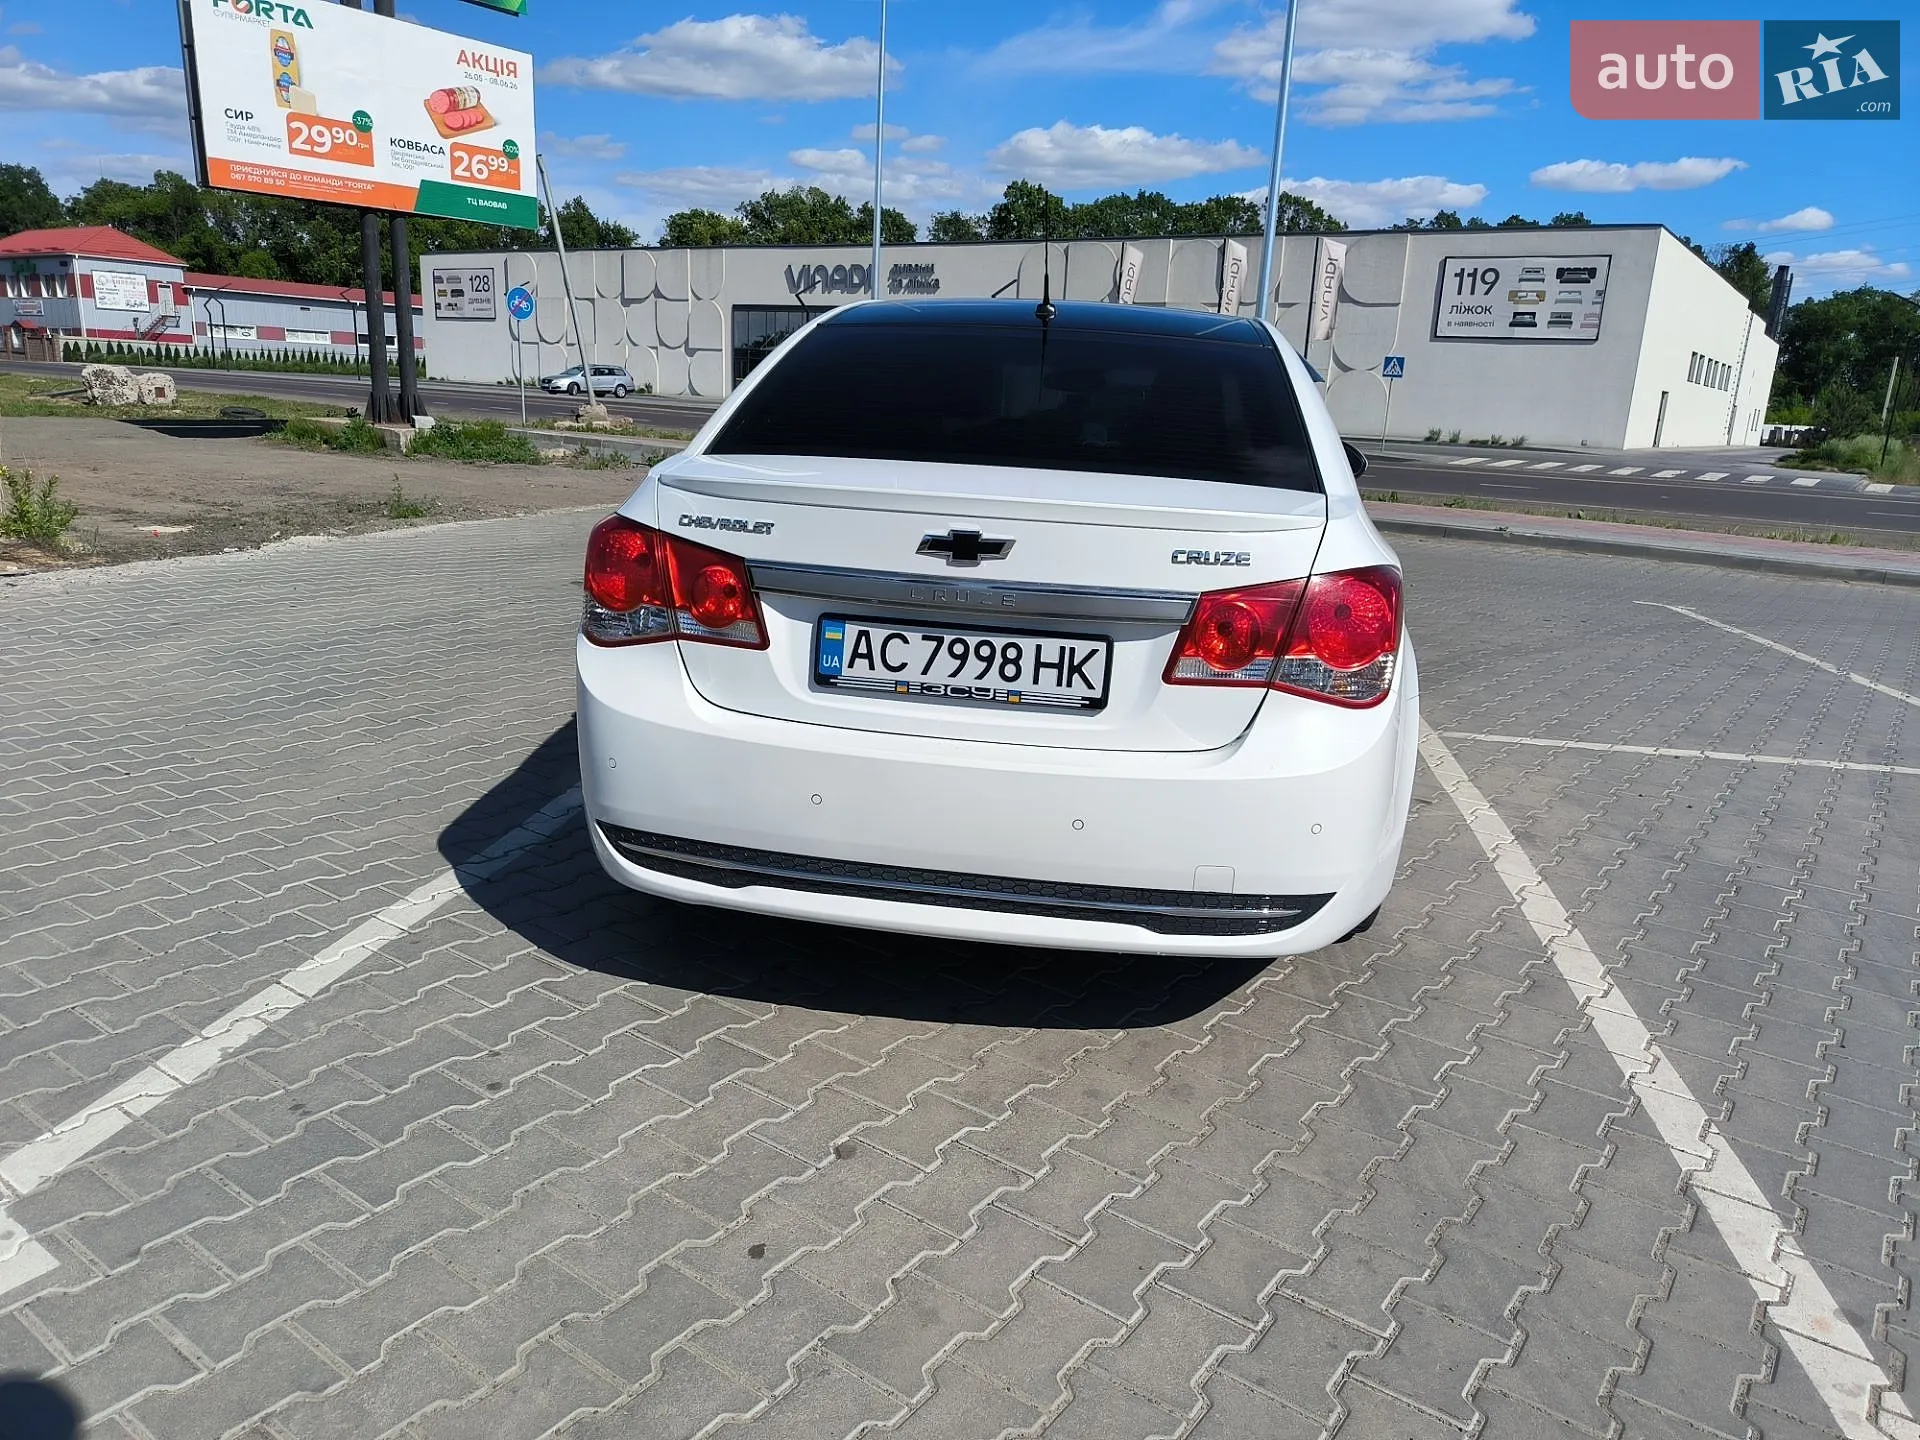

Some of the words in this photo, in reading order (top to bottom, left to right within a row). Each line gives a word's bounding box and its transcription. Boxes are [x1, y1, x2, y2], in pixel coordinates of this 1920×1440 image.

[213, 9, 270, 28] СУПЕРМАРКЕТ
[457, 49, 518, 78] АКЦІЯ
[224, 108, 254, 122] СИР
[390, 137, 446, 156] КОВБАСА
[230, 164, 288, 179] ПРИЄДНУЙСЯ
[290, 173, 302, 182] ДО
[303, 175, 344, 187] КОМАНДИ
[466, 197, 478, 207] ТЦ
[469, 275, 491, 292] 128
[1454, 267, 1500, 296] 119
[1454, 320, 1495, 328] наявності
[679, 514, 775, 535] CHEVROLET
[1171, 549, 1251, 566] CRUZE
[910, 587, 1016, 607] CRUZE
[823, 653, 840, 669] UA
[920, 634, 1024, 683] 7998
